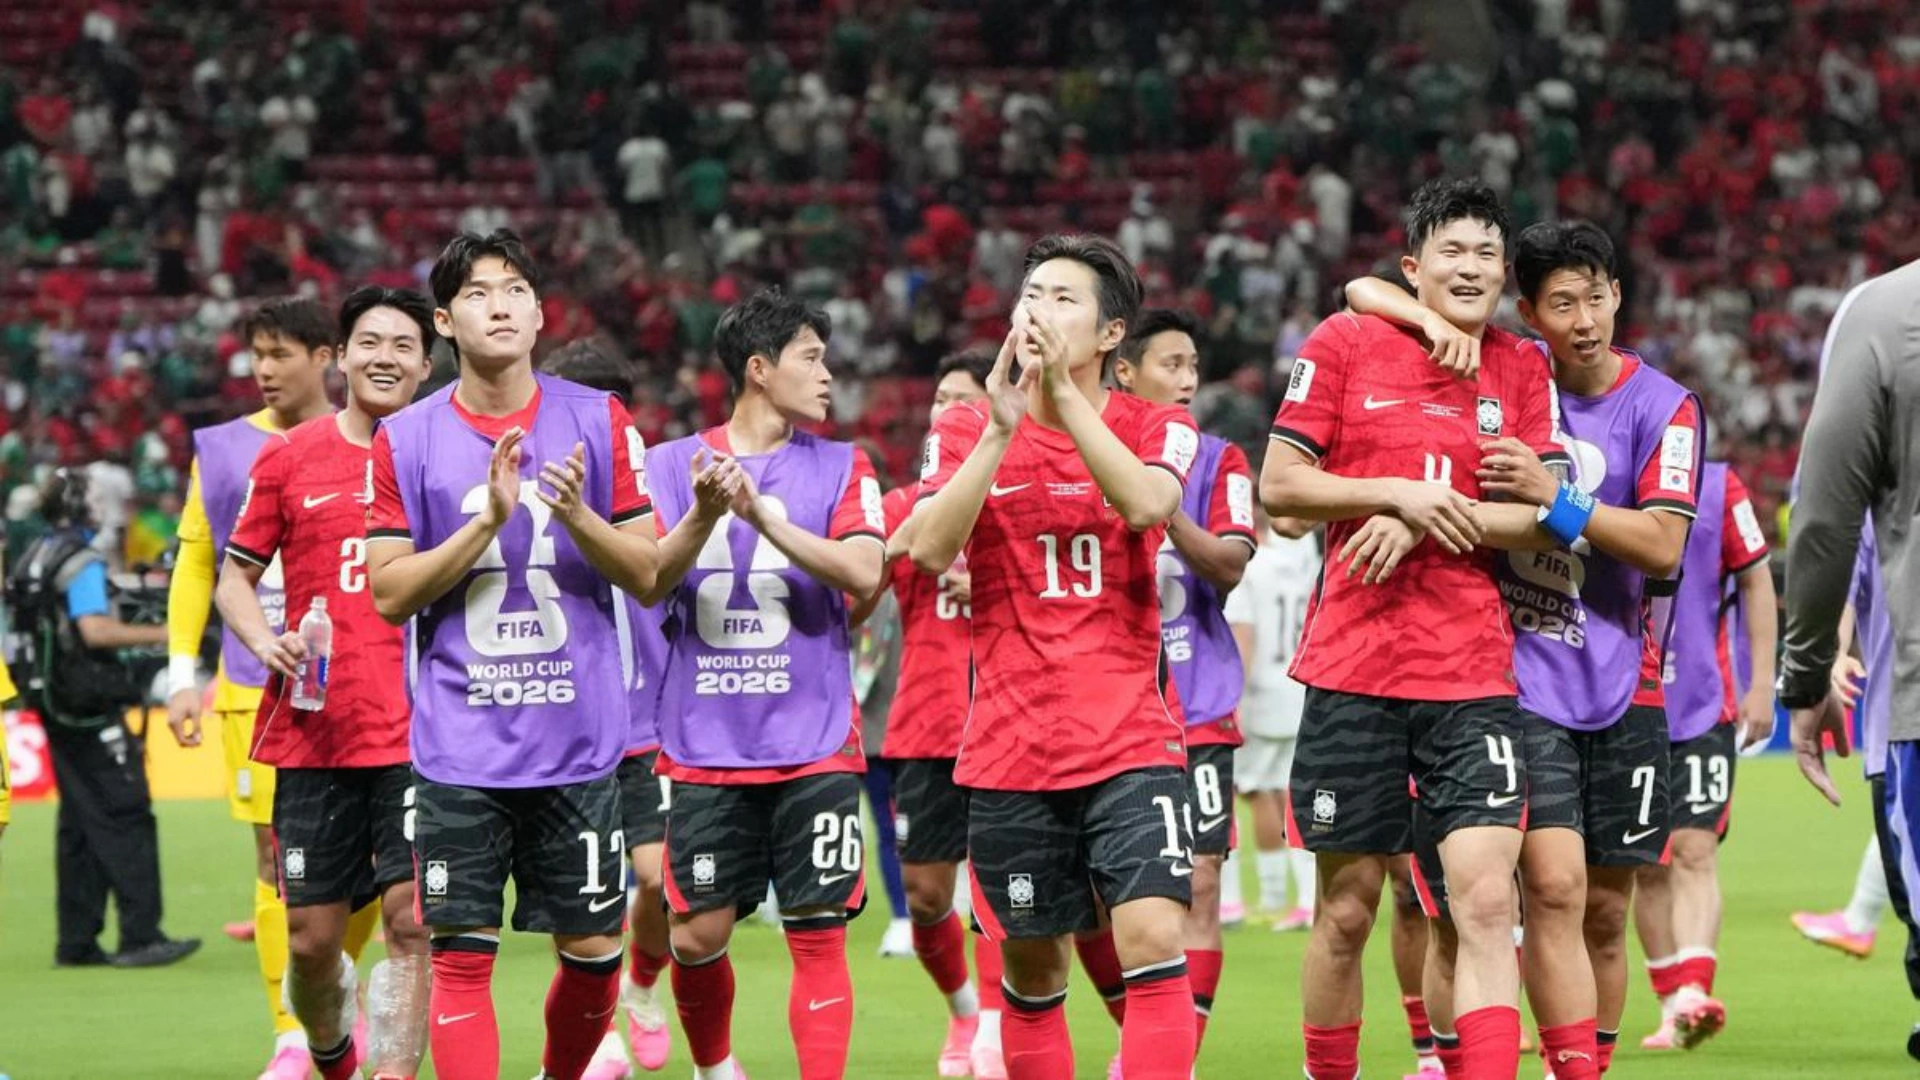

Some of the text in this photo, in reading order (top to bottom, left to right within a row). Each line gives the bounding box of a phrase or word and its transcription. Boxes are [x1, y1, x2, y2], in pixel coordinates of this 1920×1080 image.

[1037, 533, 1102, 599] 19
[1533, 551, 1571, 581] FIFA
[1500, 580, 1587, 624] WORLD CUP
[497, 620, 544, 639] FIFA
[723, 618, 764, 634] FIFA
[1508, 604, 1585, 649] 026
[466, 661, 573, 679] WORLD CUP
[696, 654, 791, 670] WORLD CUP
[696, 671, 791, 694] 2026
[467, 680, 575, 706] 2026
[1484, 734, 1517, 792] 4
[1684, 754, 1729, 803] 13
[1194, 763, 1223, 816] 8
[1630, 766, 1655, 825] 7
[812, 811, 861, 871] 26
